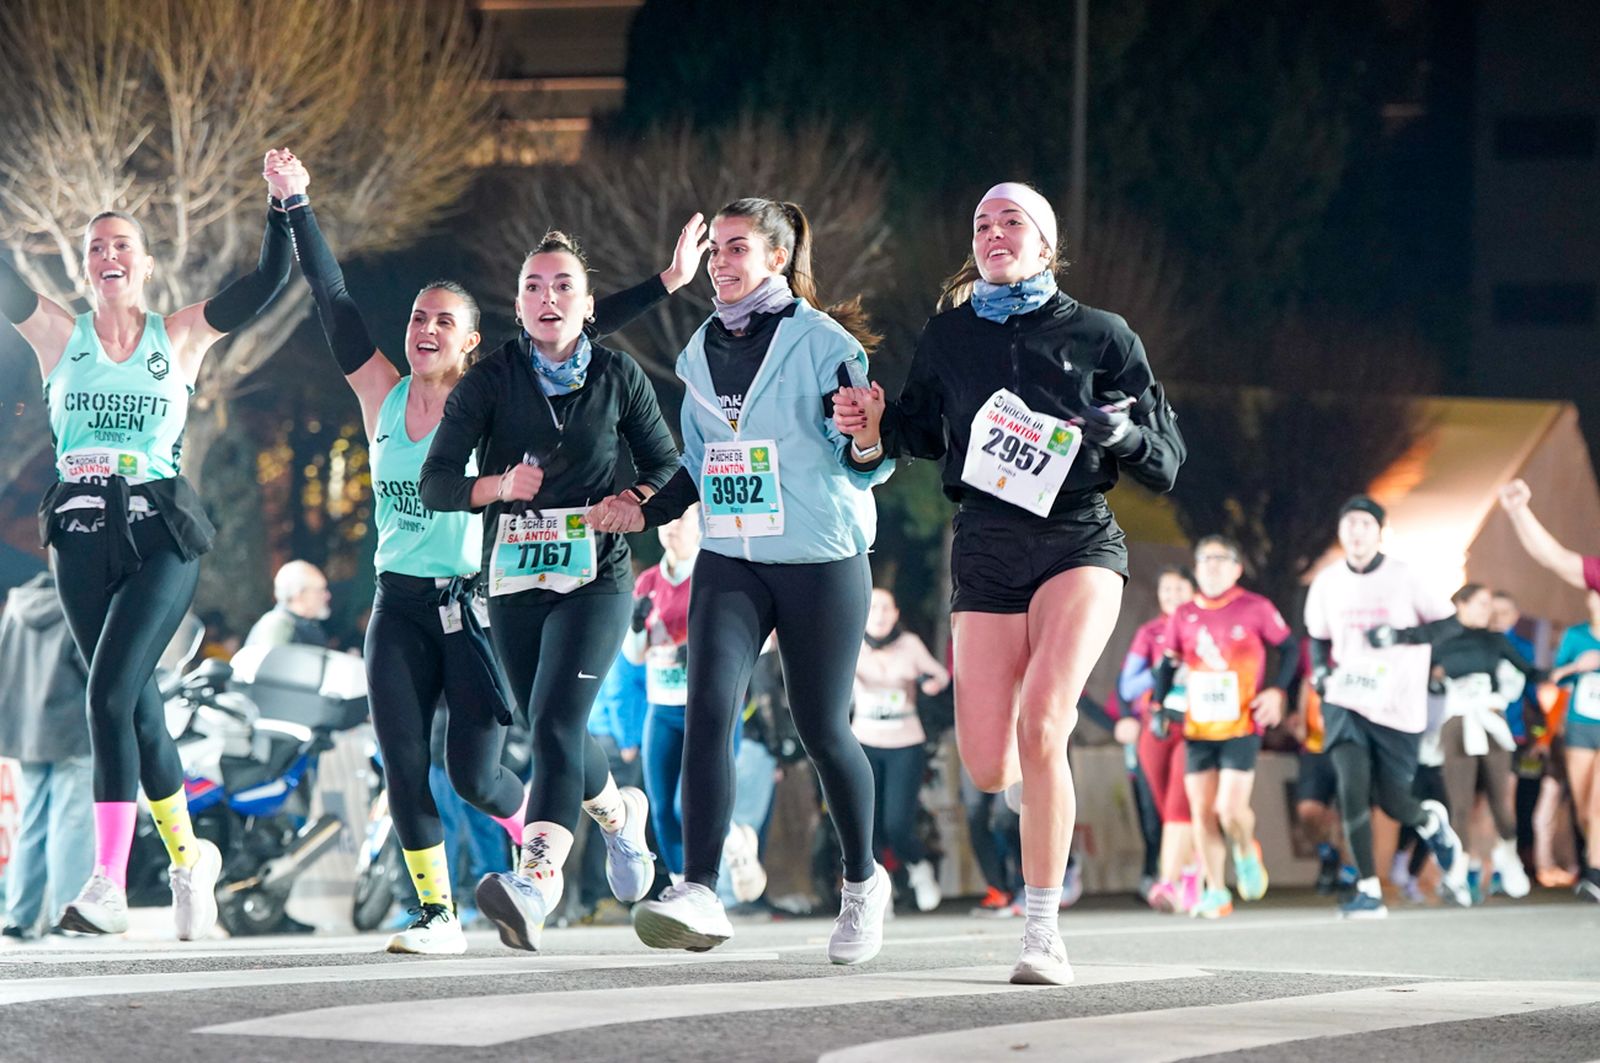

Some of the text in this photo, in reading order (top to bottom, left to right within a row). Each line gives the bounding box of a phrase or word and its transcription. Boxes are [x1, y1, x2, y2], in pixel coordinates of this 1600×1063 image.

[65, 392, 172, 417] CROSSFIT
[87, 413, 145, 432] JAEN
[735, 452, 743, 461] DE
[981, 427, 1052, 477] 2957
[374, 480, 419, 498] ROS
[711, 475, 764, 505] 3932
[523, 519, 558, 530] OCHE DE
[518, 542, 572, 569] 7767
